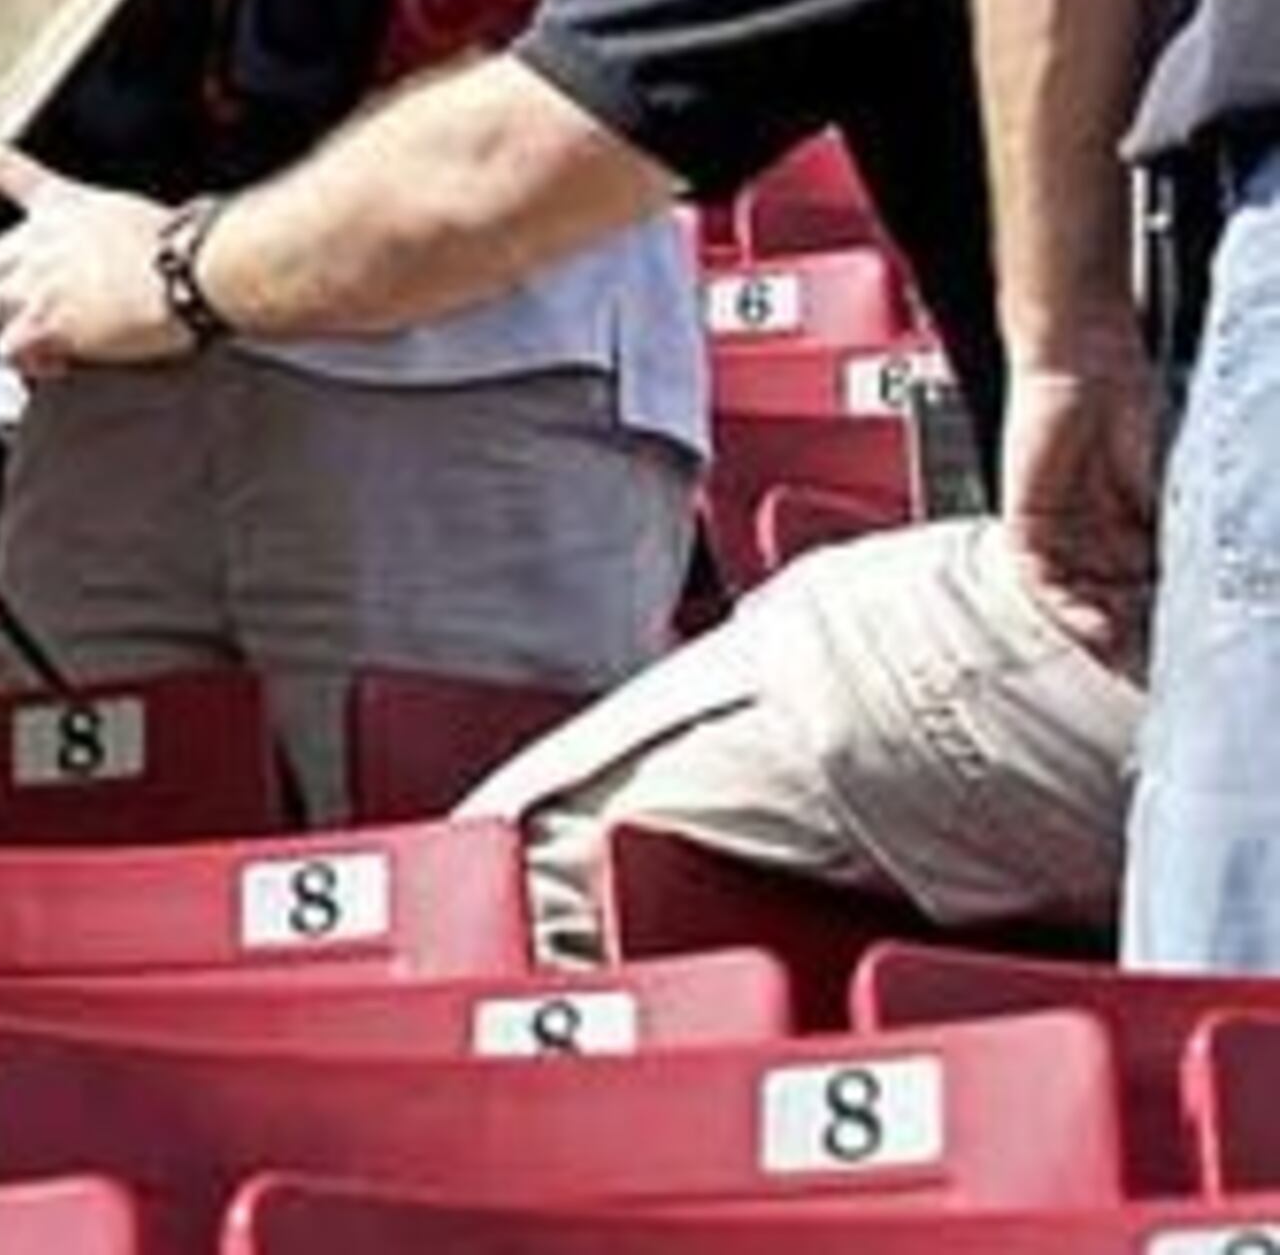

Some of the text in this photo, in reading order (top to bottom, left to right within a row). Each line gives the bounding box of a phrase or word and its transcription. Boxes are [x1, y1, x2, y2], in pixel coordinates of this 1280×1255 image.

[58, 706, 105, 772] 8
[290, 860, 339, 936] 8
[823, 1069, 883, 1162] 8
